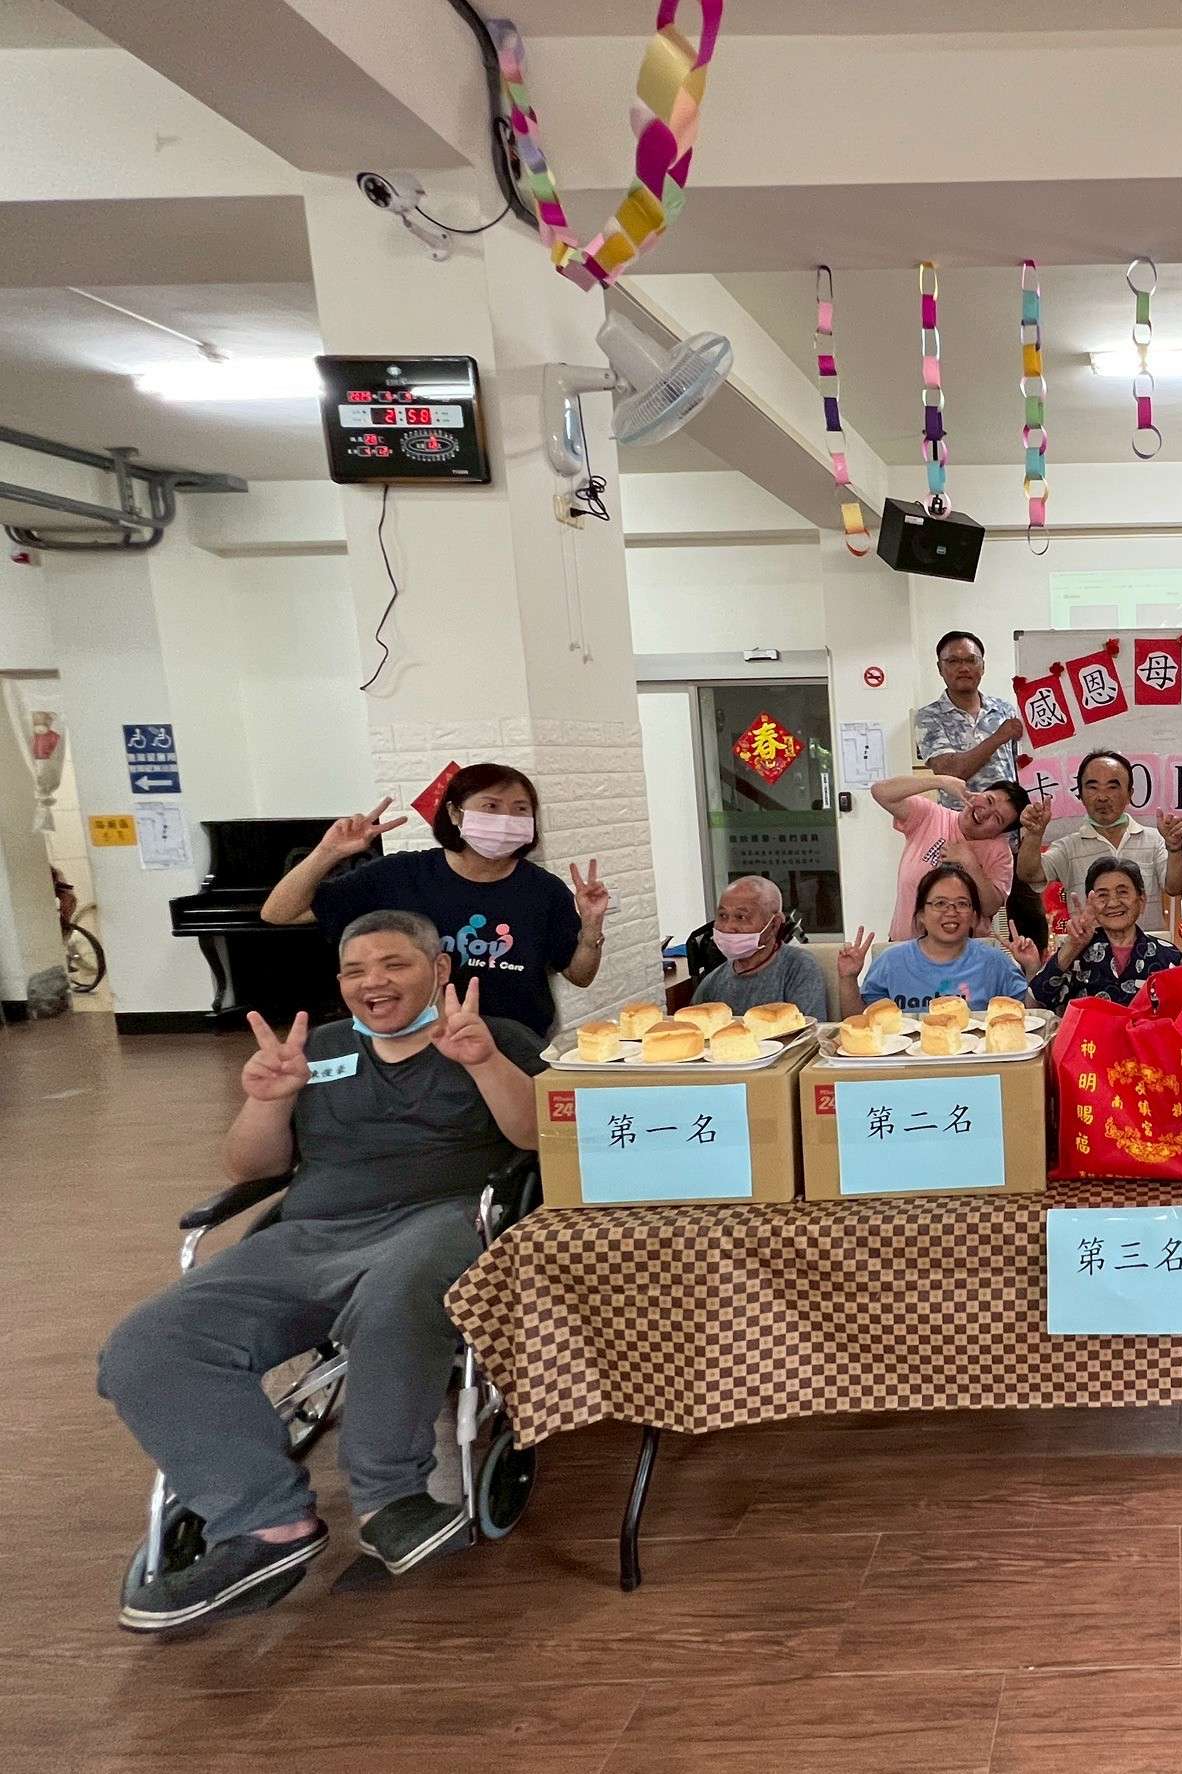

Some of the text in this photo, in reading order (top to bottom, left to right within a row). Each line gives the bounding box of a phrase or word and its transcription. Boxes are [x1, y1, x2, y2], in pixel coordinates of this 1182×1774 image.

[751, 722, 787, 760] 春
[500, 961, 524, 972] Care
[1075, 1039, 1097, 1154] 神明賜福
[608, 1114, 717, 1149] 第一名
[866, 1104, 971, 1140] 第二名
